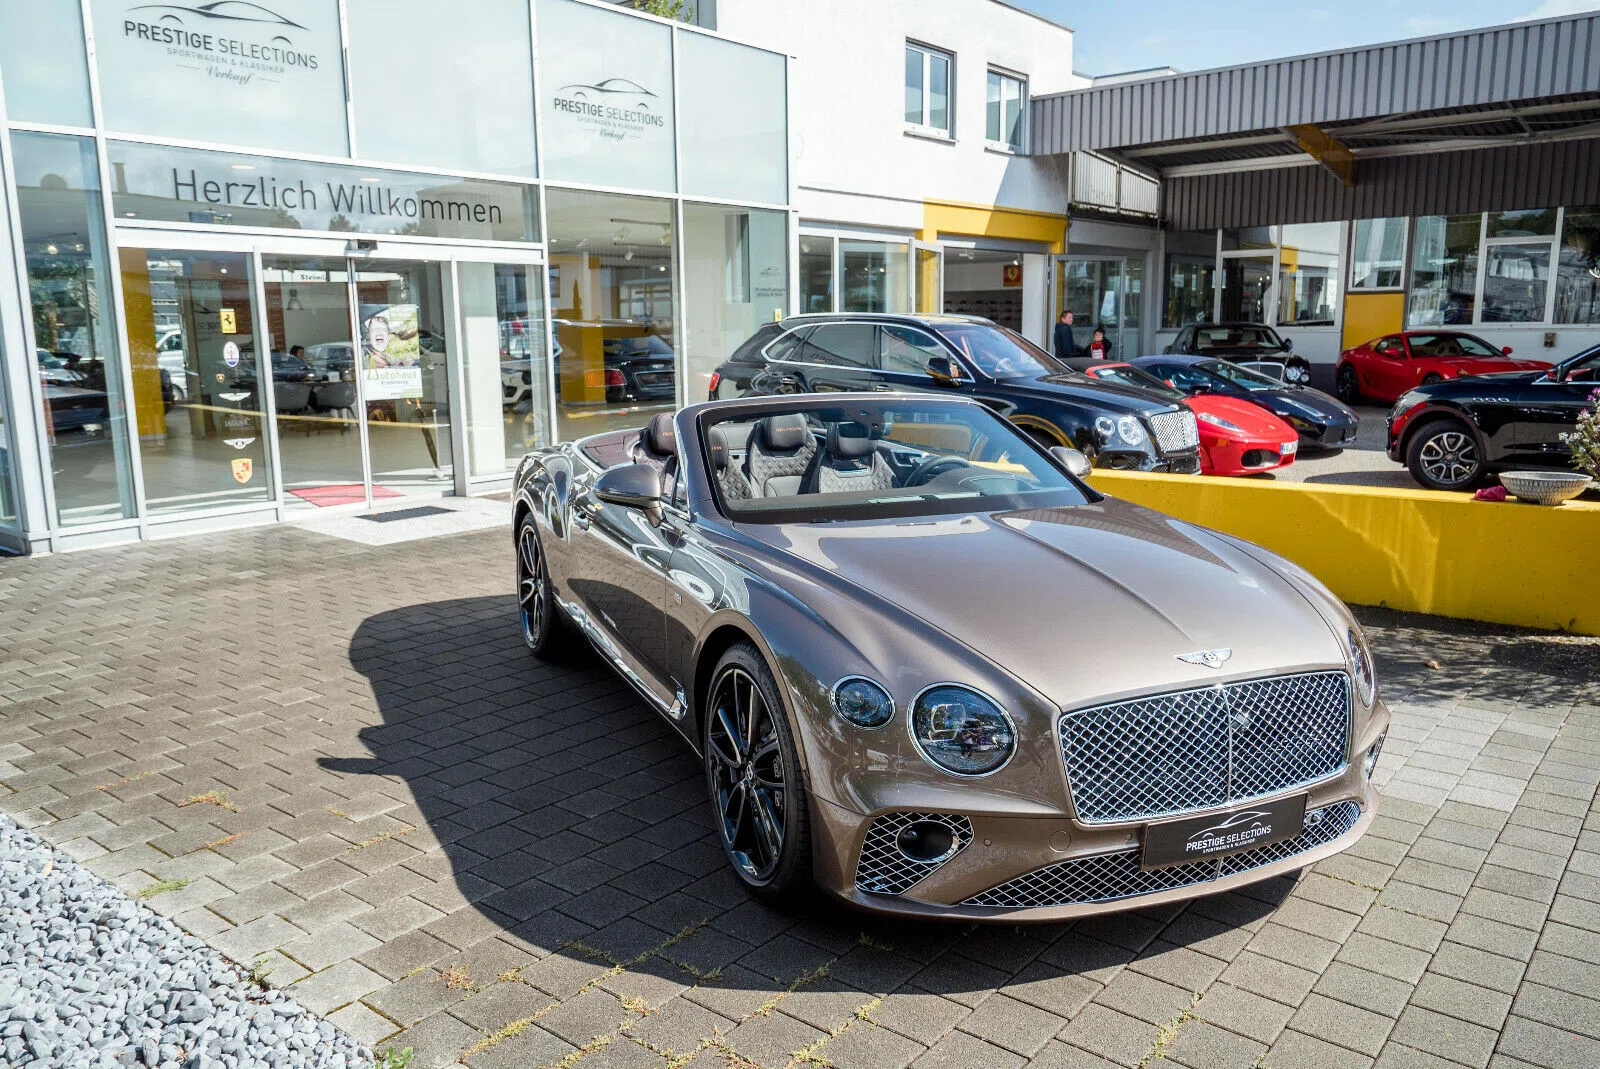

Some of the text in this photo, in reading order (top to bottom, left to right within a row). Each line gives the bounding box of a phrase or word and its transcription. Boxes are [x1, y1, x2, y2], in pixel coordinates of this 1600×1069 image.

[124, 20, 319, 69] PRESTIGE SELECTIONS
[167, 47, 228, 64] SPORTWAGEN
[240, 60, 285, 74] KLASSIKER
[206, 66, 253, 85] Verkauf
[554, 97, 665, 127] PRESTIGE SELECTIONS
[172, 168, 503, 224] Herzlich Willkommen
[1185, 825, 1272, 852] PRESTIGE SELECTIONS
